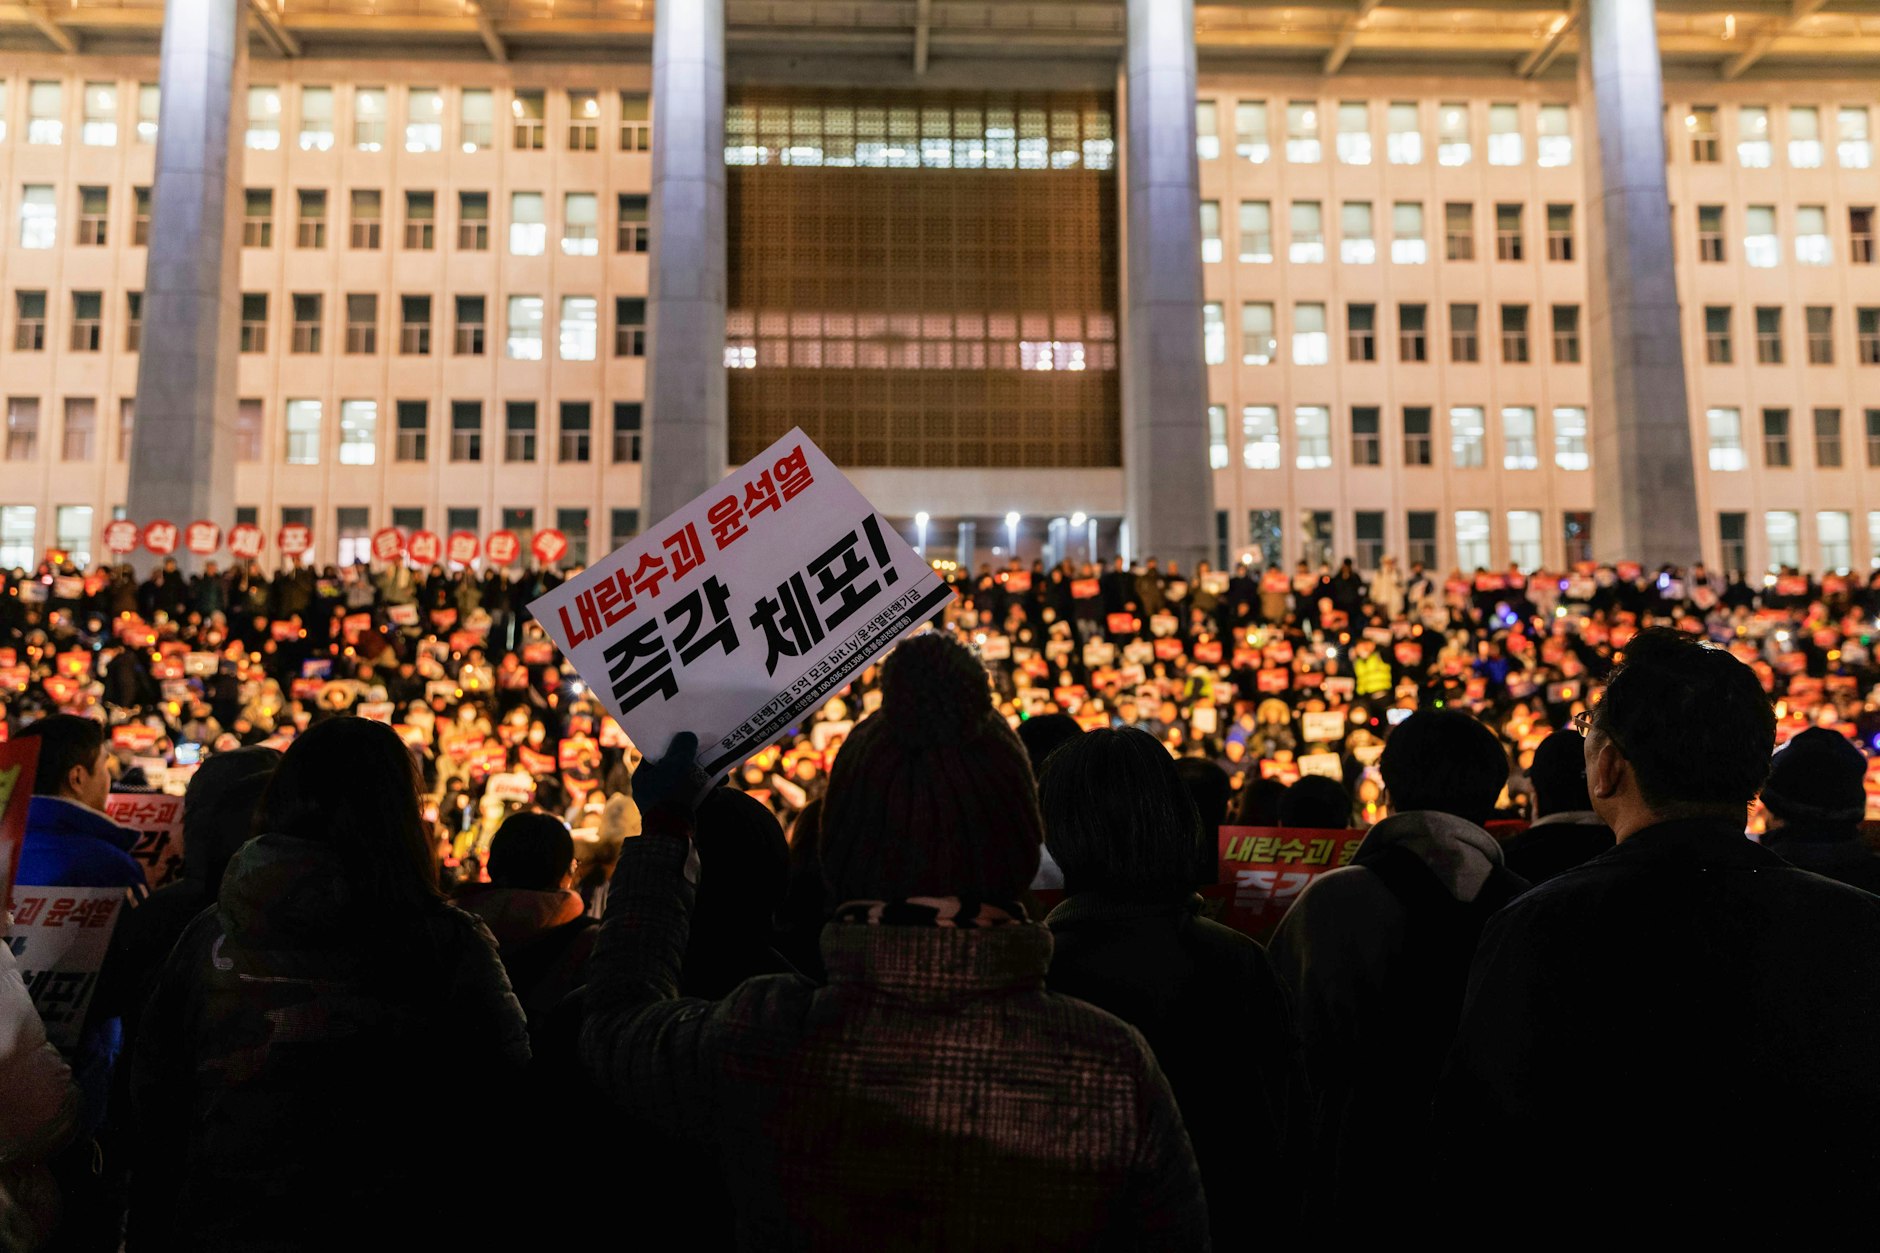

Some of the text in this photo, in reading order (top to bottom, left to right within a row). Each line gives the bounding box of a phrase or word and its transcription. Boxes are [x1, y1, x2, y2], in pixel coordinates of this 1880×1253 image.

[558, 444, 814, 650] 내란수괴 윤석열
[602, 513, 899, 715] 즉각 체포!
[721, 588, 922, 750] 윤석열 탄핵기금 5억 모금 bit.ly/윤석열탄핵기금
[794, 690, 820, 712] 신한은행
[817, 653, 865, 693] 100-036-551308
[1223, 836, 1337, 866] 내란수괴
[43, 897, 122, 928] 윤석열
